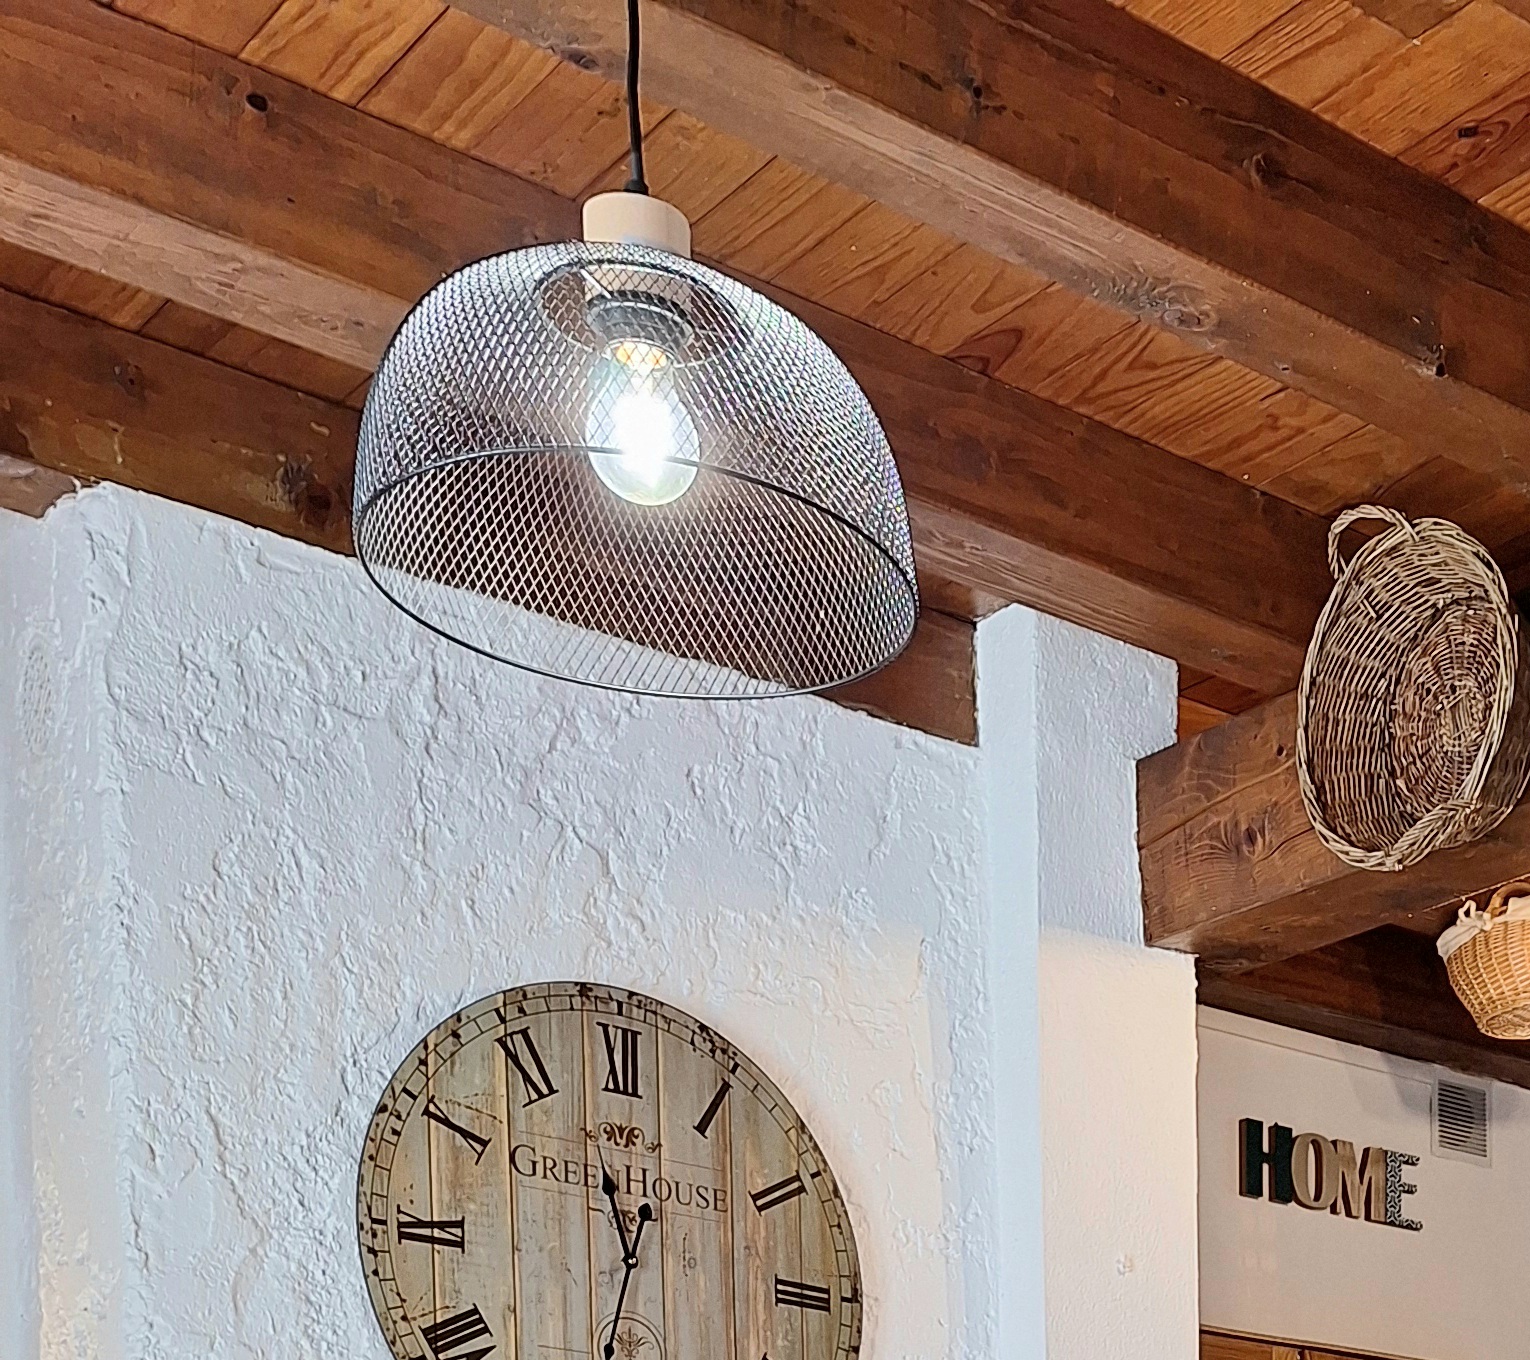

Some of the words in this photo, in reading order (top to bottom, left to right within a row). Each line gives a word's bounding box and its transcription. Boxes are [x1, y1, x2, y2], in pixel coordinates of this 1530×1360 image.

[494, 1026, 559, 1108] XI
[596, 1021, 643, 1098] XII
[421, 1094, 492, 1166] X
[693, 1077, 734, 1139] I
[748, 1170, 808, 1216] II
[1239, 1117, 1424, 1232] HOME
[396, 1204, 466, 1254] IX
[774, 1273, 831, 1315] III
